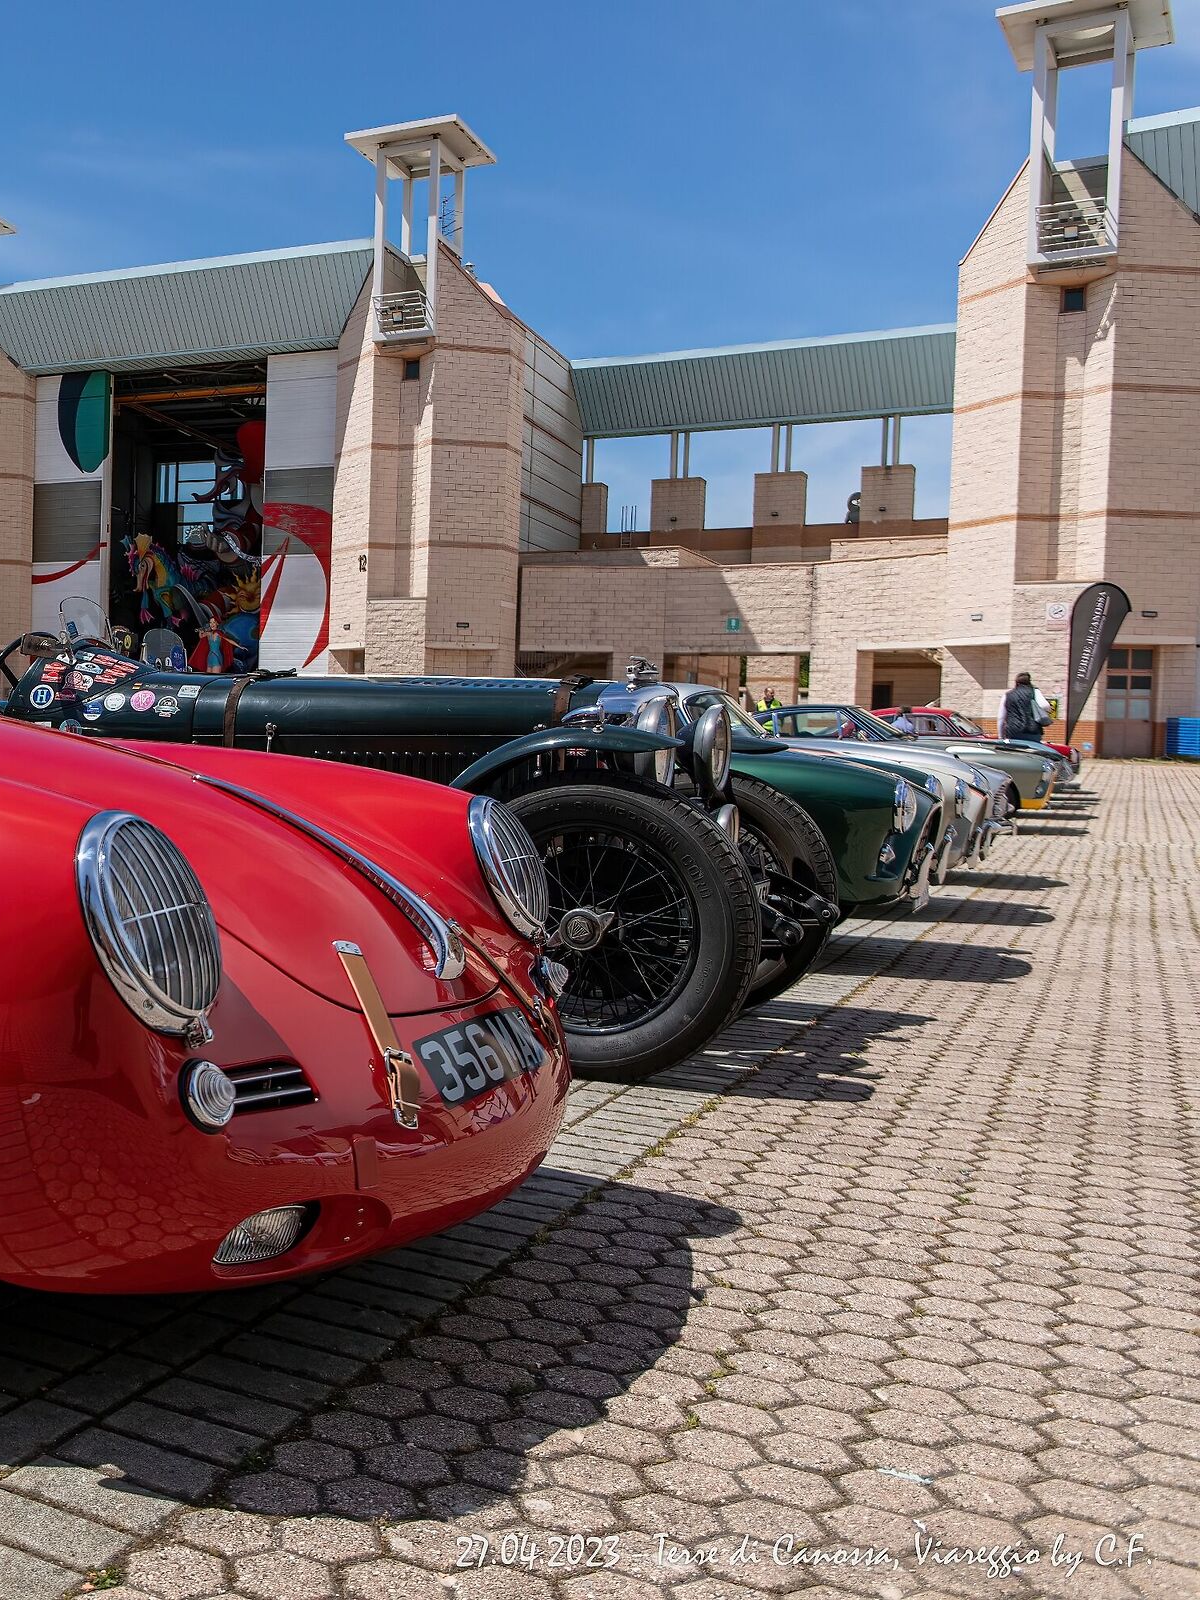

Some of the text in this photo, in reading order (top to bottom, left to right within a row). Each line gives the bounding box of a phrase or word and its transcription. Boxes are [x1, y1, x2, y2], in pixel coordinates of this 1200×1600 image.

[358, 554, 367, 573] 12
[1076, 645, 1091, 680] TERRE
[1089, 591, 1107, 635] CANOSSA
[420, 1022, 505, 1102] 356
